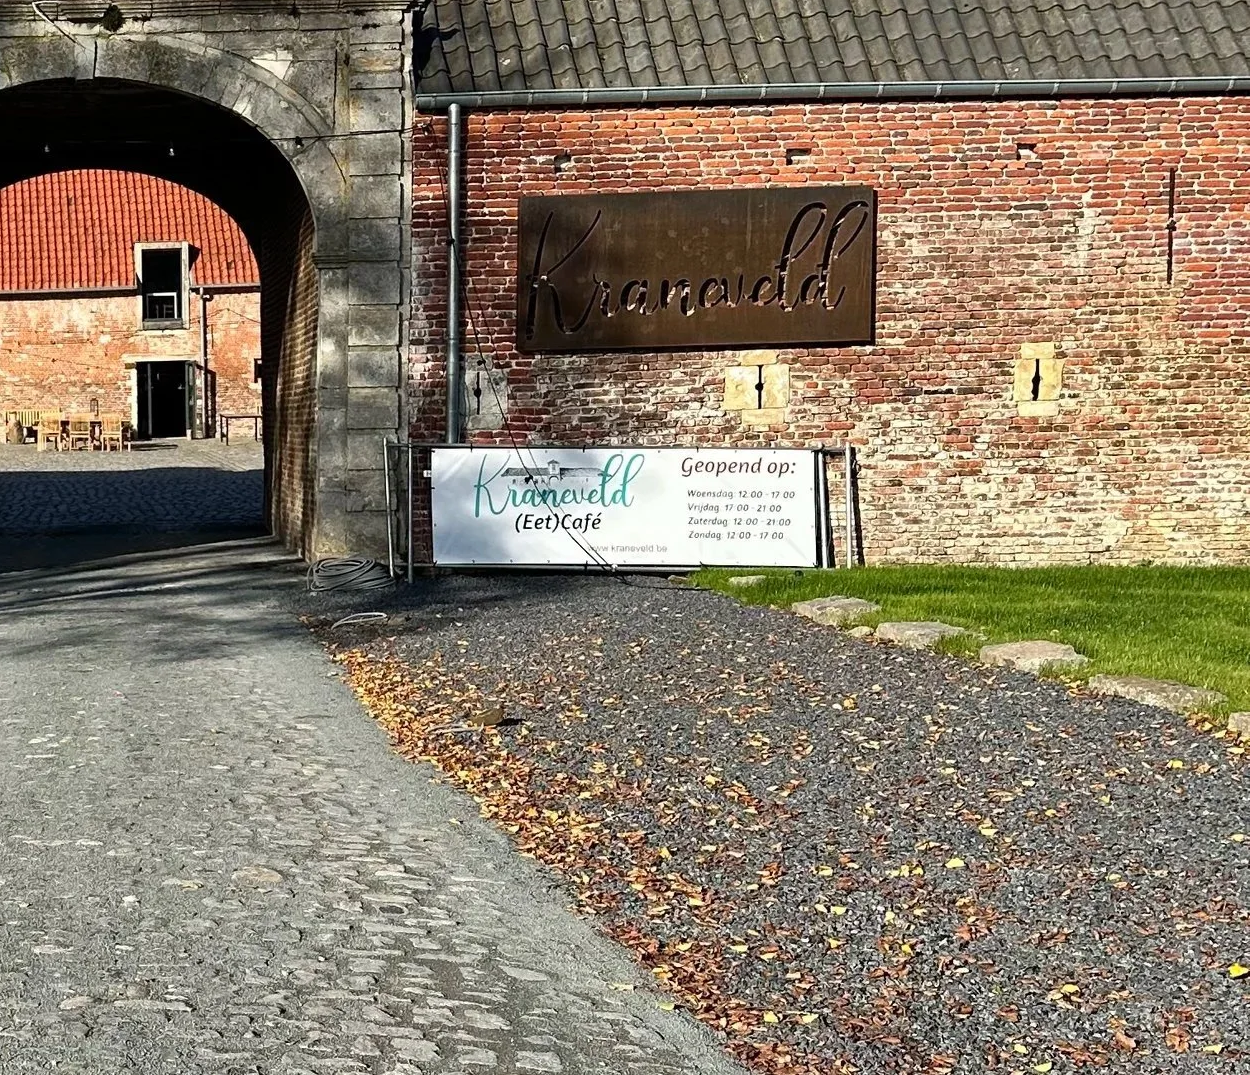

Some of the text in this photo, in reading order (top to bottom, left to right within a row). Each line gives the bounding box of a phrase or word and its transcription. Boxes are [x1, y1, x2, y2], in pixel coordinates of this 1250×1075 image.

[525, 200, 869, 341] Kraneveld
[473, 453, 645, 518] Kraneveld
[681, 456, 797, 478] Geopend op:
[514, 512, 602, 533] (Eet)Café
